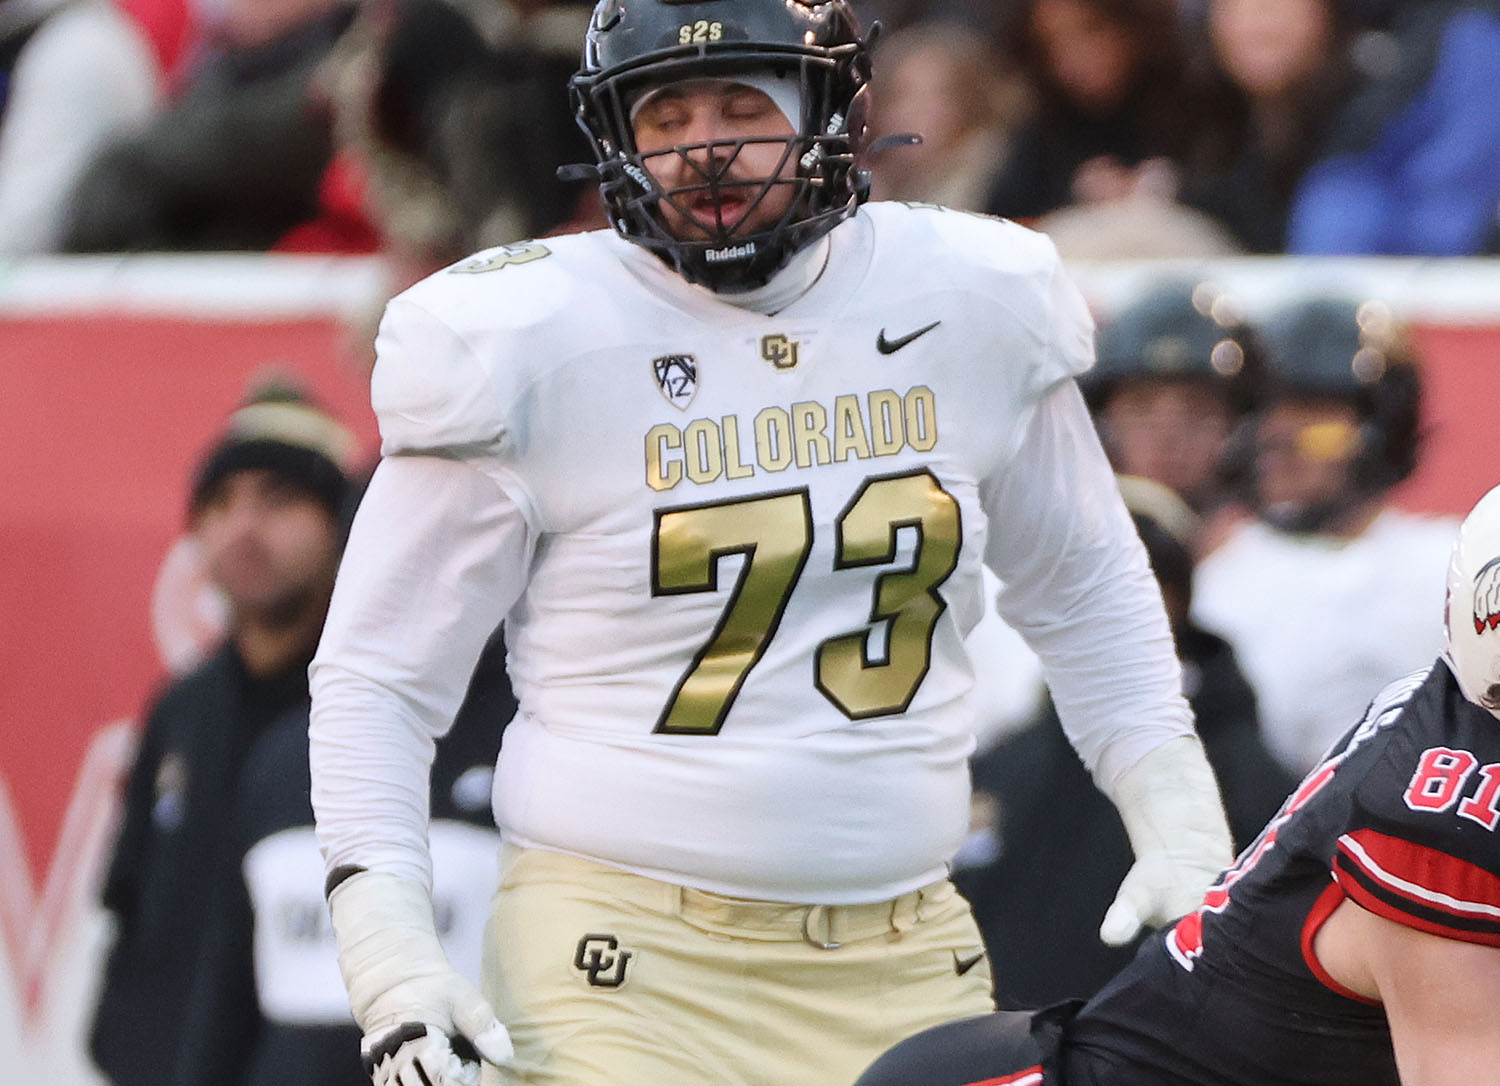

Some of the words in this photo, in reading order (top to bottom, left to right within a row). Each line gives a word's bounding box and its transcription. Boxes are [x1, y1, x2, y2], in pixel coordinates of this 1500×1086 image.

[760, 333, 799, 370] CU
[644, 384, 938, 492] COLORADO
[651, 466, 963, 736] 73
[573, 933, 632, 988] CU
